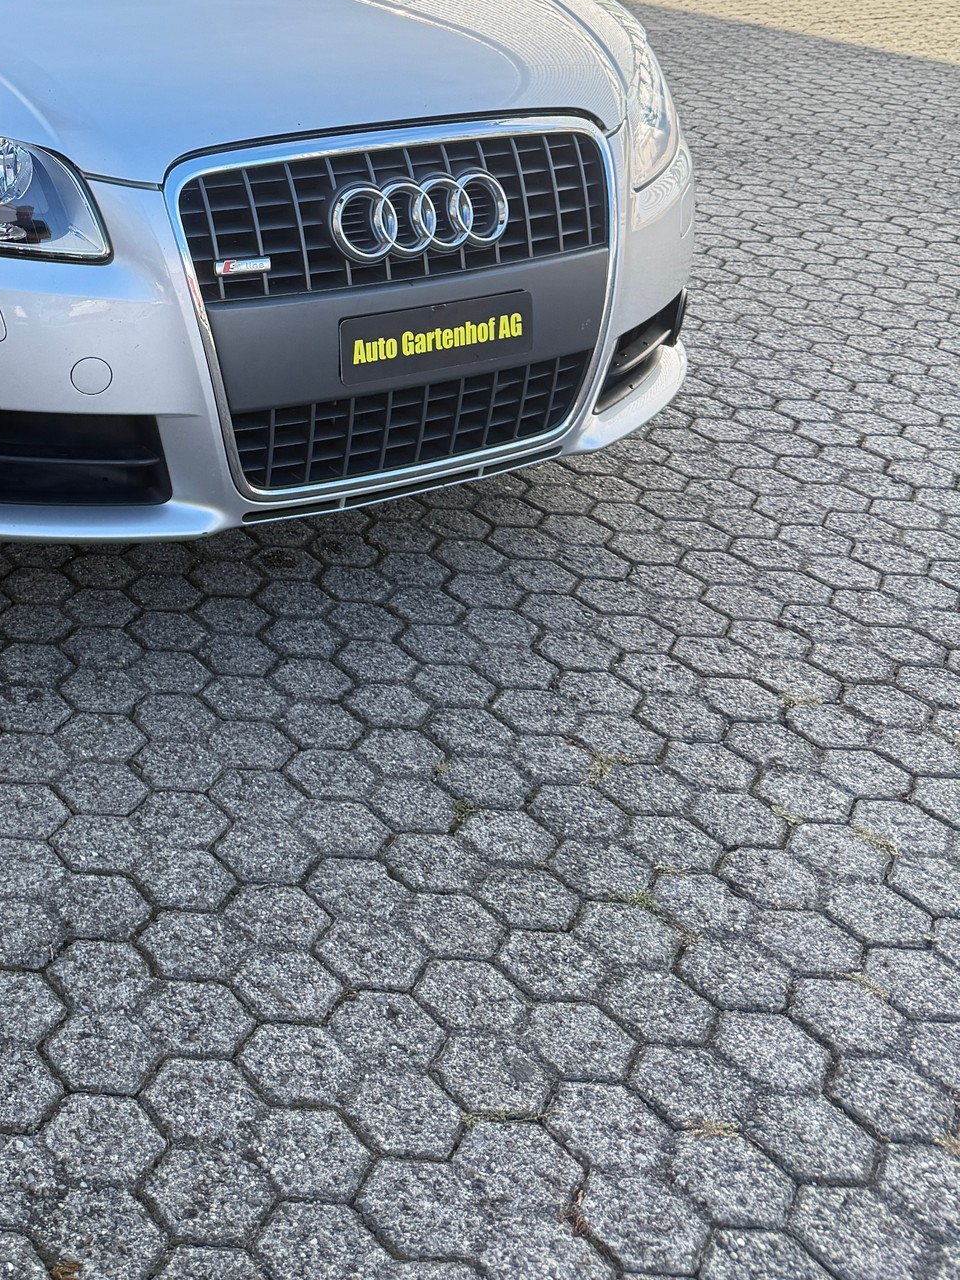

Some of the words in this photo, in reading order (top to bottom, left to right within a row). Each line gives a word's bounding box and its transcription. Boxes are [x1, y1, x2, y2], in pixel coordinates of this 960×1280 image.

[353, 337, 398, 365] Auto
[401, 317, 496, 357] Gartenhof
[498, 312, 523, 339] AG
